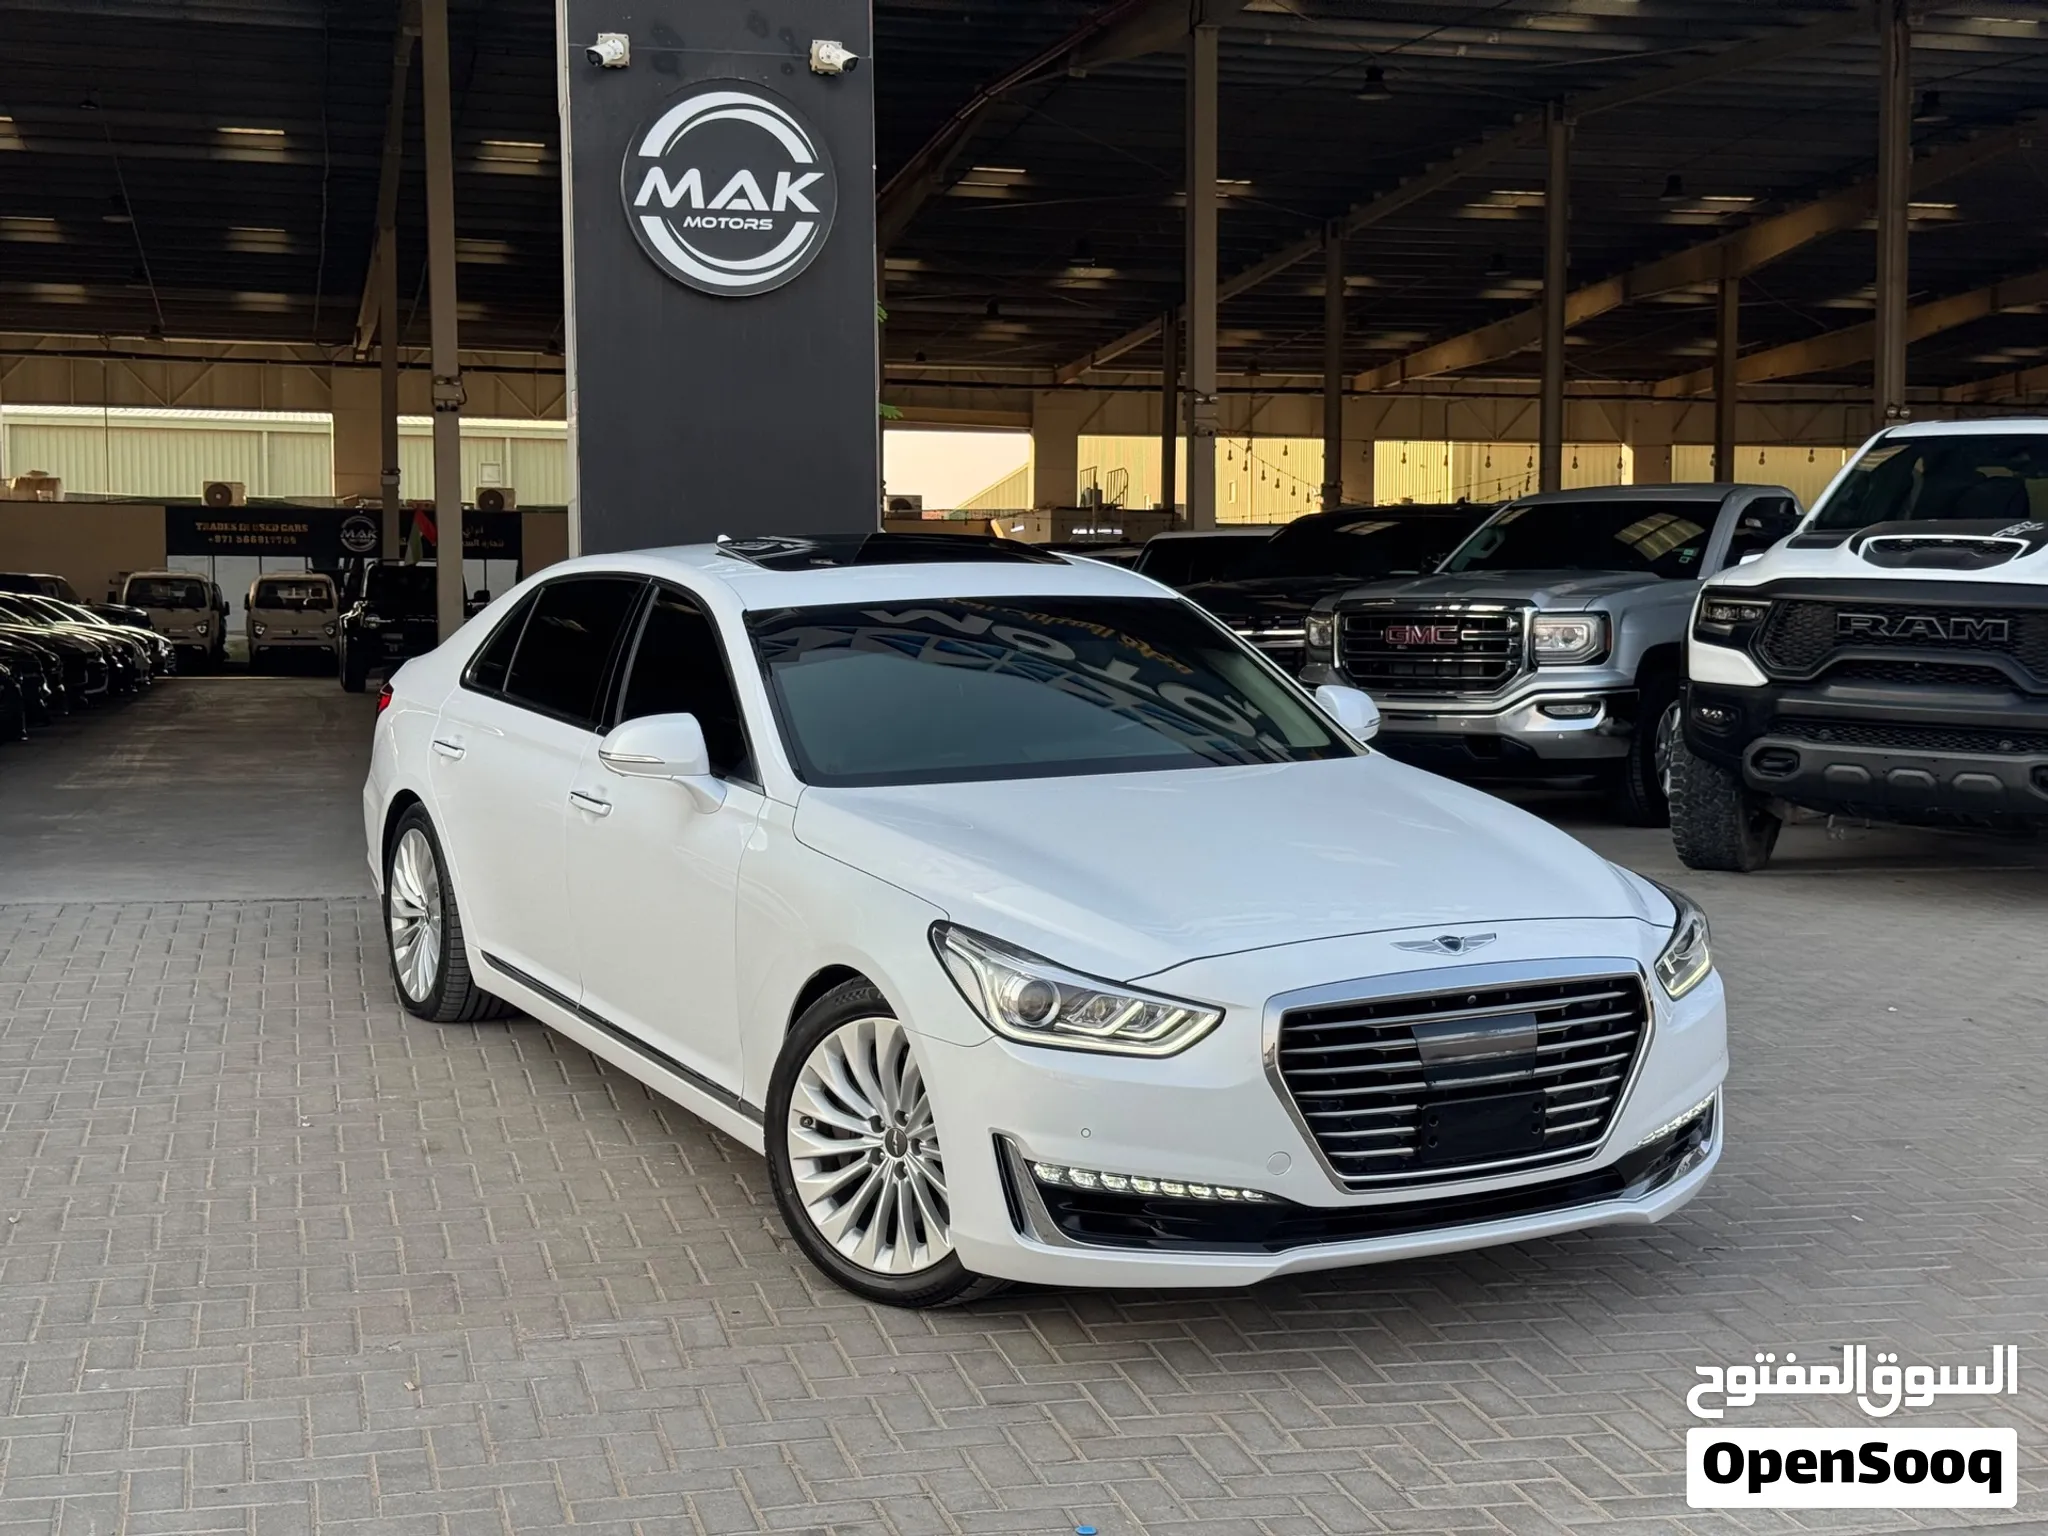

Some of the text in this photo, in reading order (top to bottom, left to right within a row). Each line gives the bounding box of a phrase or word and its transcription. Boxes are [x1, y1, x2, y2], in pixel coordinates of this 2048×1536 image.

[633, 166, 825, 213] MAK
[683, 215, 774, 230] MOTORS
[281, 524, 308, 533] CARS
[340, 529, 379, 539] MAK
[1385, 624, 1459, 645] GMC
[1836, 613, 2009, 642] RAM
